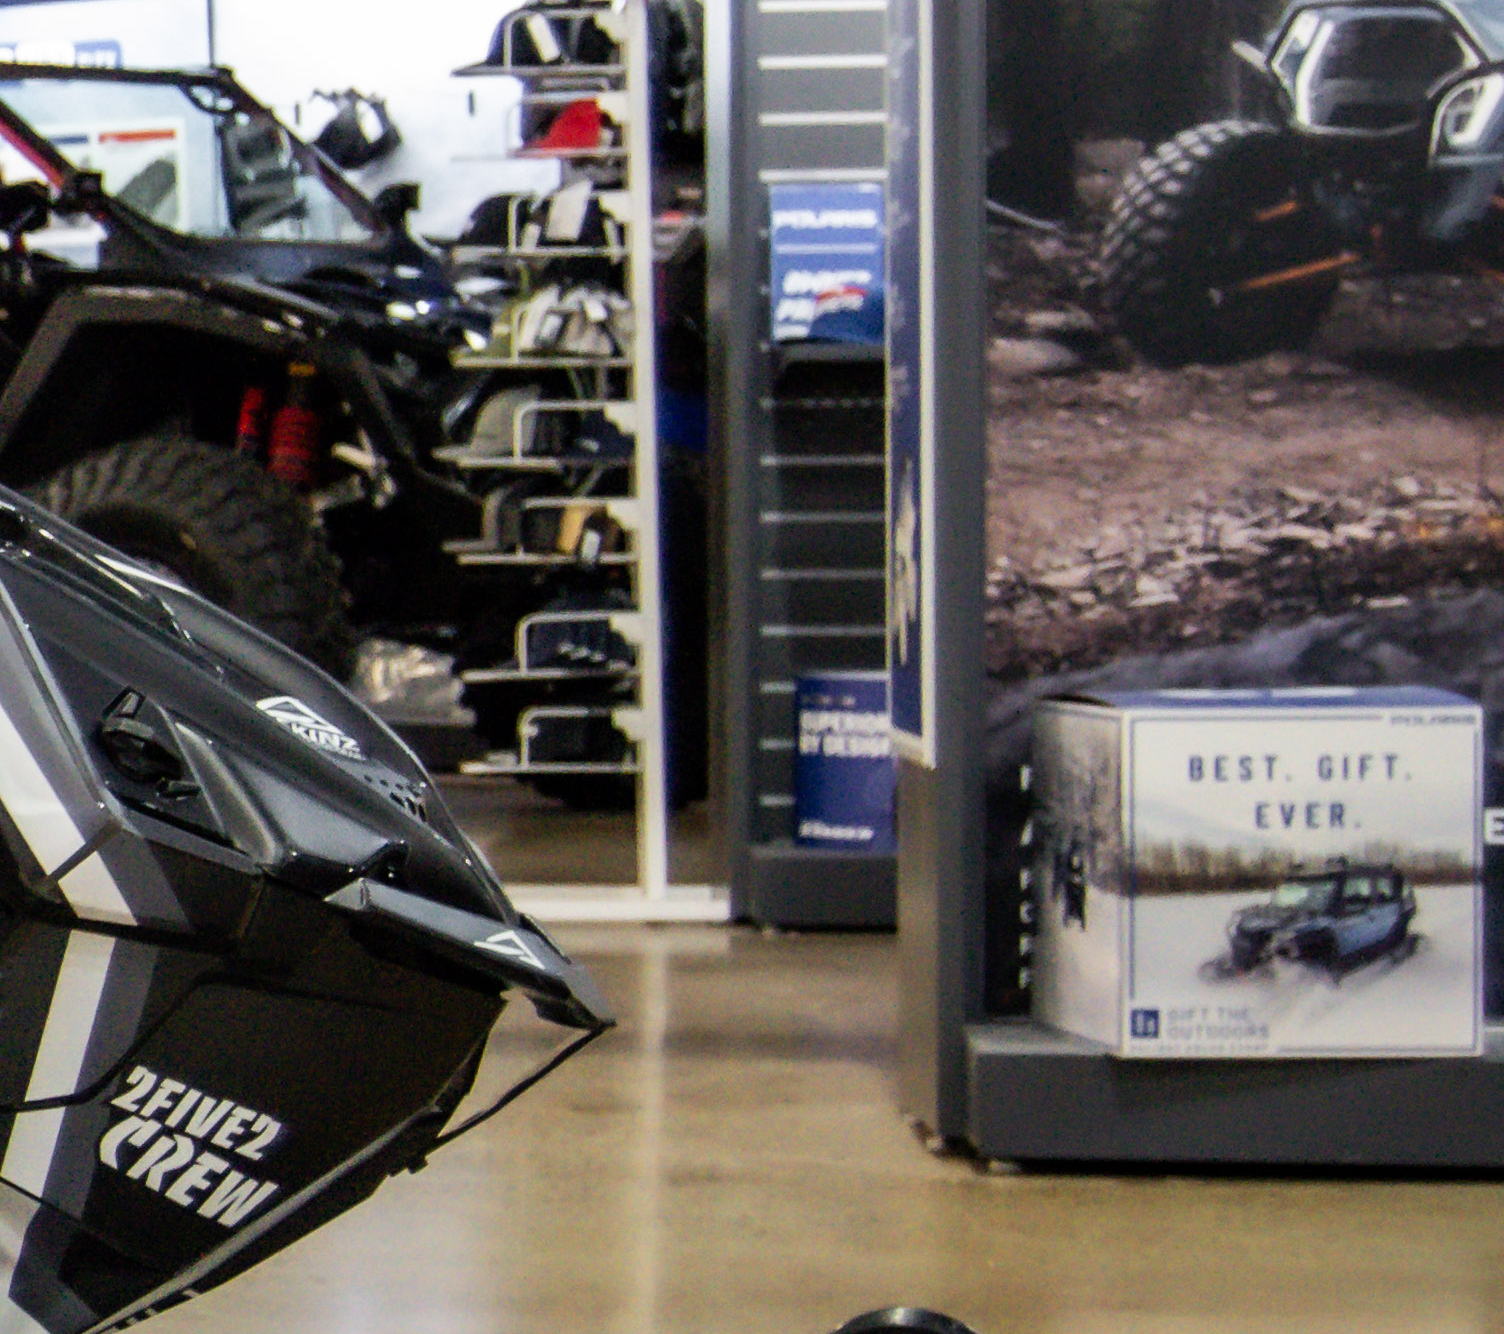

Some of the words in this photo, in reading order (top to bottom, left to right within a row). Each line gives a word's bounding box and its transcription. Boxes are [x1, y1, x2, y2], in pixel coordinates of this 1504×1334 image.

[1188, 753, 1292, 783] BEST.
[1317, 753, 1414, 782] GIFT.
[1254, 801, 1362, 830] EVER.
[109, 1063, 287, 1163] 2FIVE2
[99, 1116, 278, 1229] CREW
